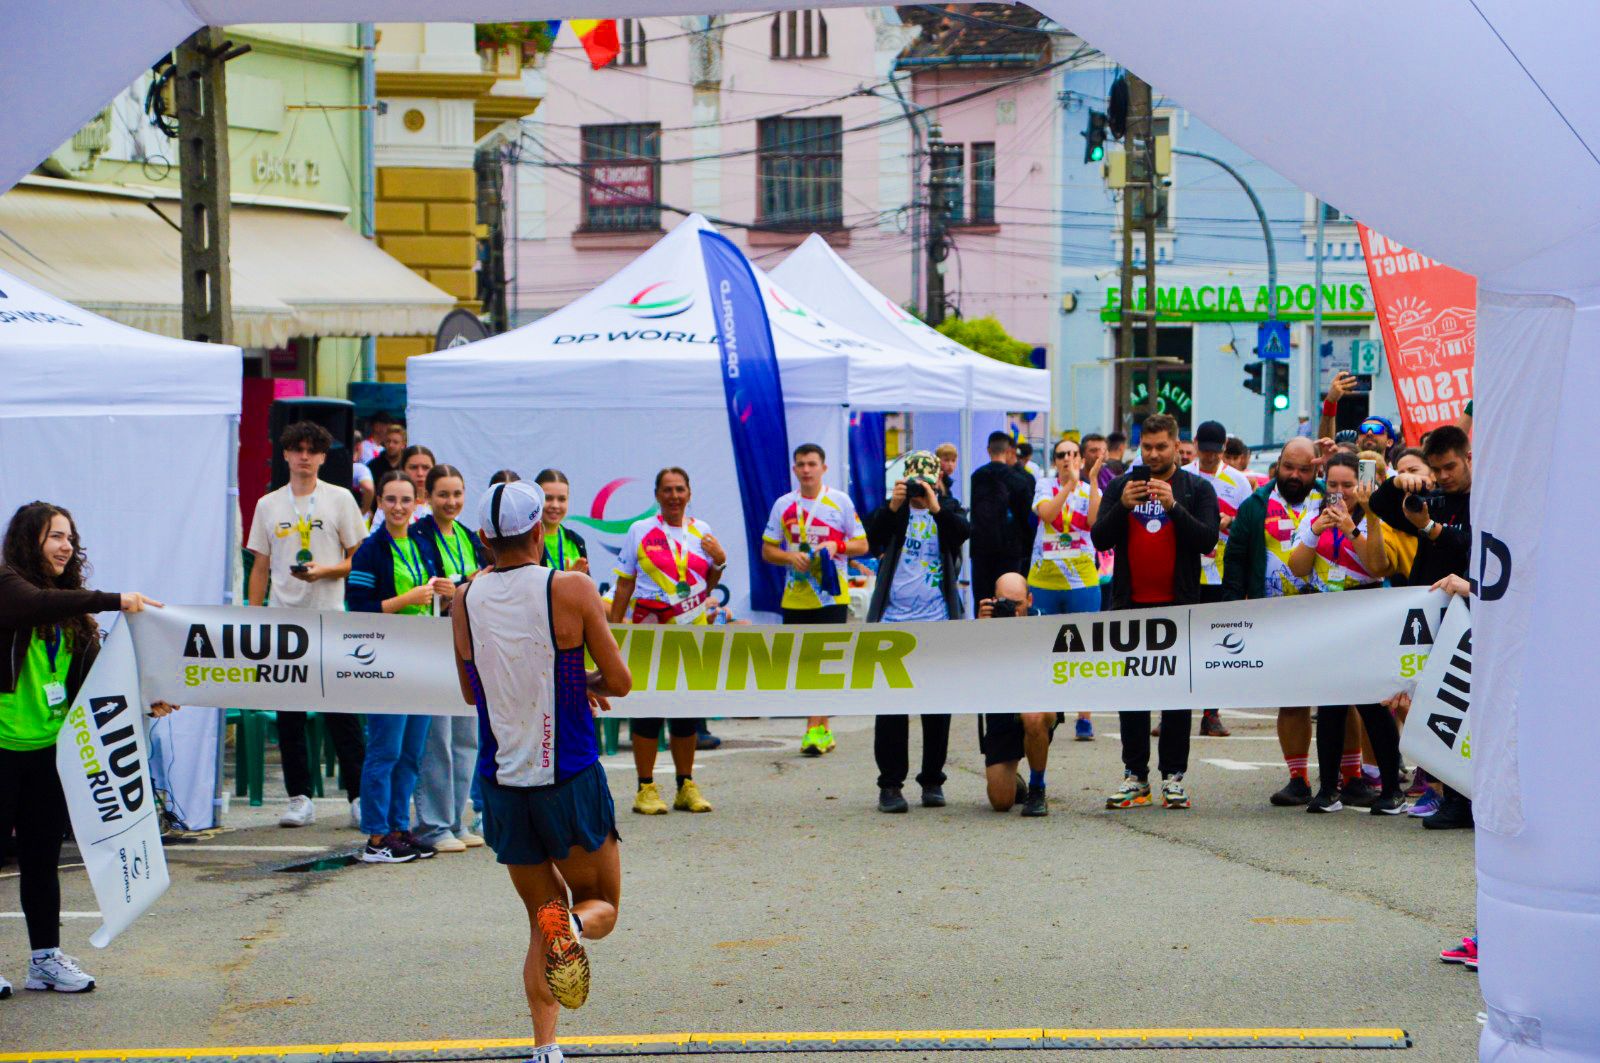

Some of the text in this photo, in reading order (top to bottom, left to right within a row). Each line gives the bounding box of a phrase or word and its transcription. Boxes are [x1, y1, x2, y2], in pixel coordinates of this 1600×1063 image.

[1254, 283, 1366, 311] ADONIS
[552, 332, 599, 345] DP
[680, 595, 701, 613] 571
[343, 632, 386, 641] powered by
[1052, 617, 1178, 653] AIUD
[1210, 620, 1254, 630] powered by
[183, 623, 310, 661] AIUD
[184, 663, 309, 688] greenRUN
[336, 671, 395, 679] DP WORLD
[1052, 655, 1178, 685] greenRUN
[1205, 660, 1264, 669] DP WORLD
[542, 712, 555, 768] GRAVITY
[68, 704, 123, 823] greenRUN
[89, 694, 145, 813] AIUD
